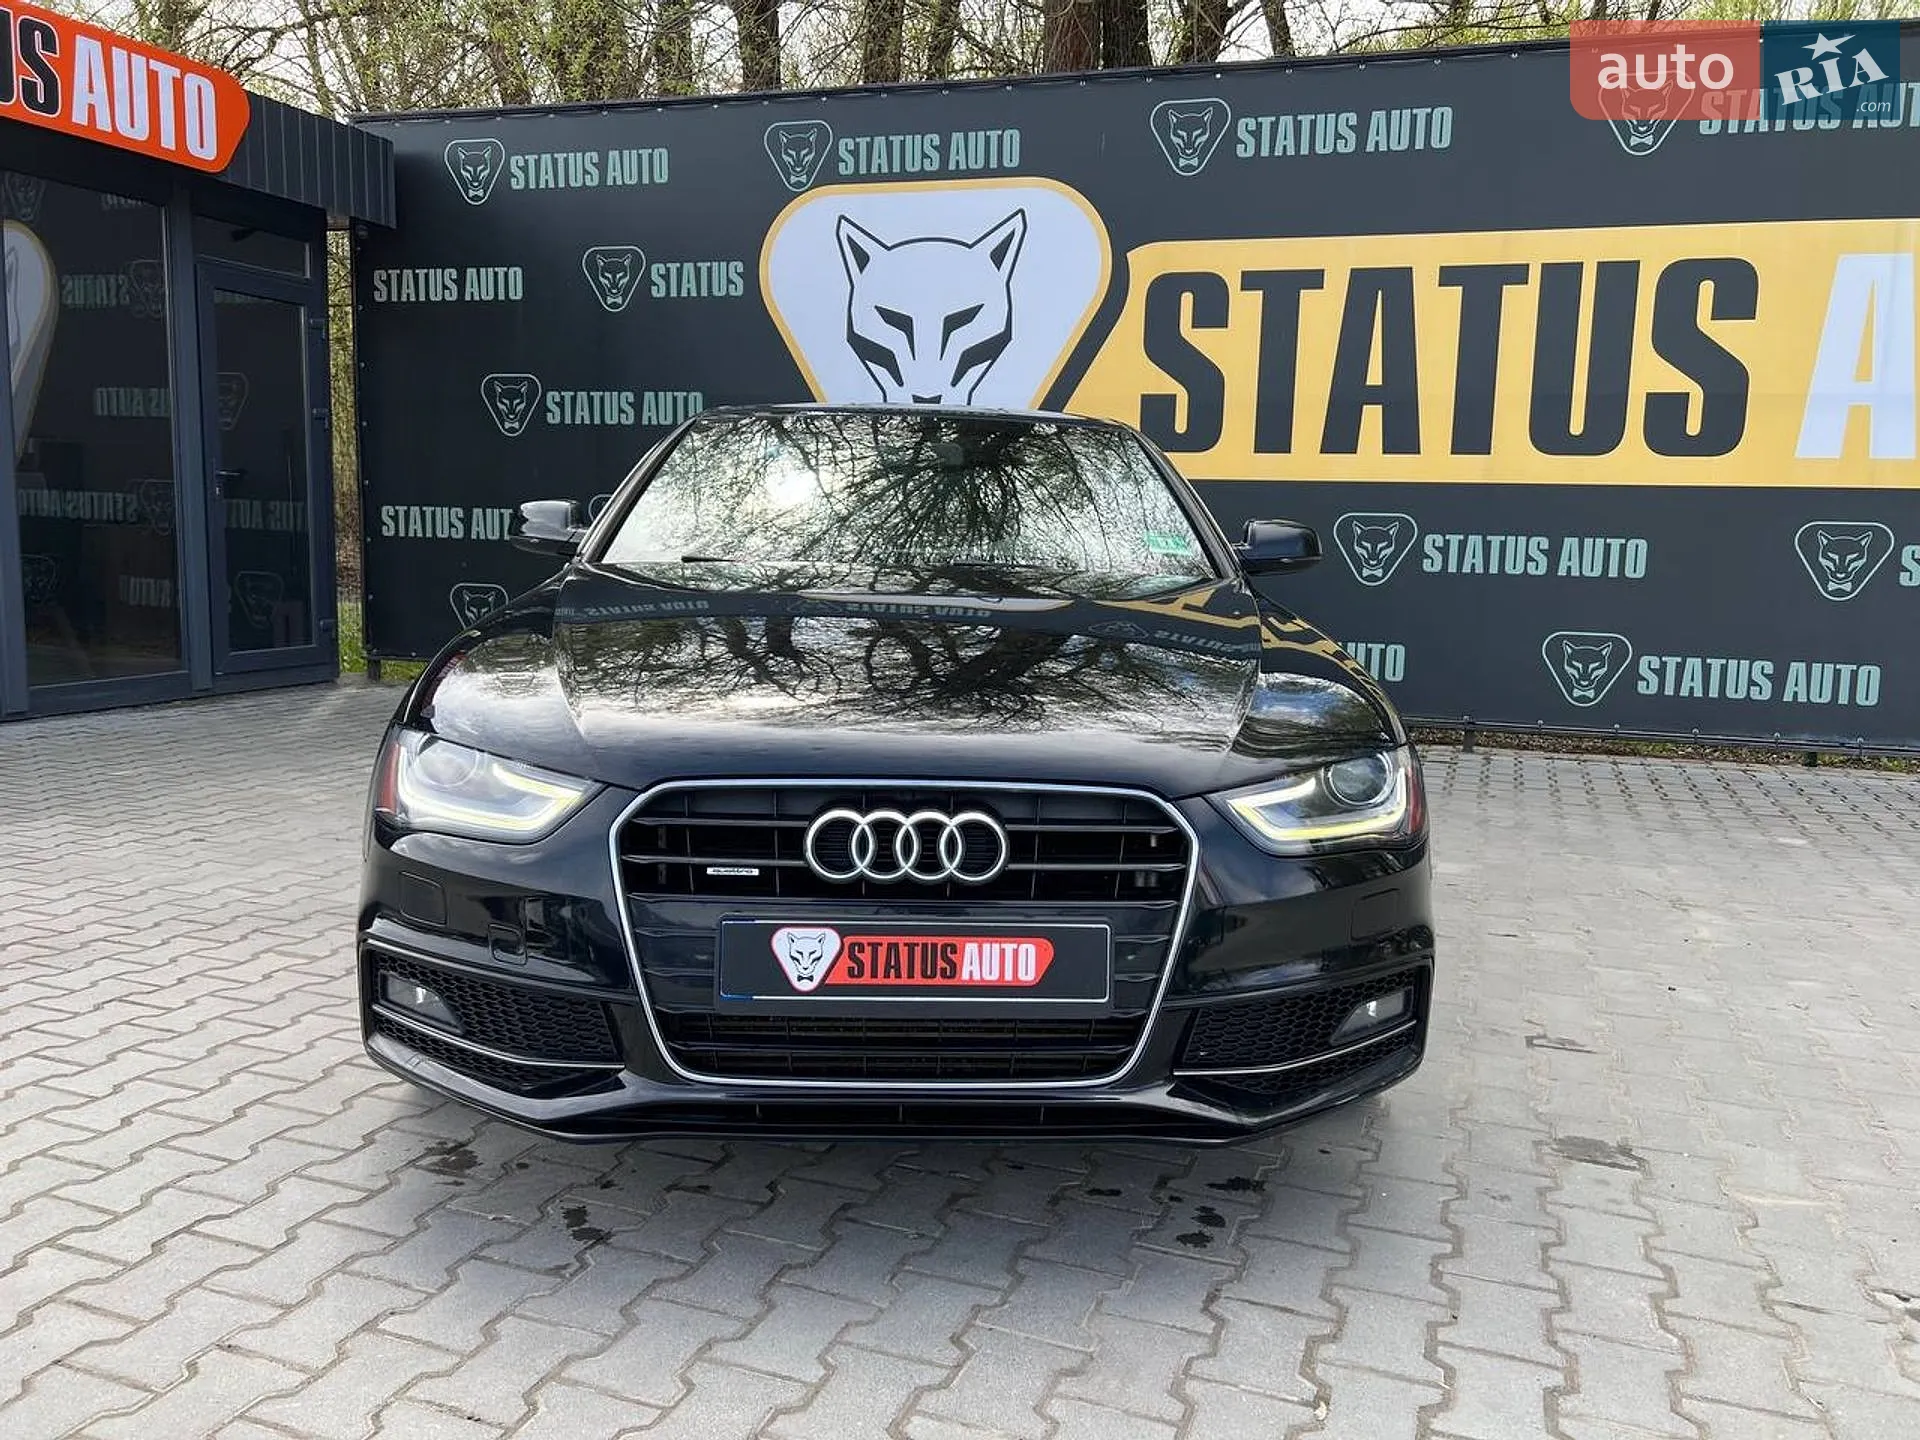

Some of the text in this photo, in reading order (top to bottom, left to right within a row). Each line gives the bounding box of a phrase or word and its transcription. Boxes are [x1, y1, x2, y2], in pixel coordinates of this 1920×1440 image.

[71, 34, 218, 161] AUTO
[1700, 85, 1842, 135] STATUS
[837, 129, 1021, 176] STATUS AUTO
[1236, 106, 1453, 159] STATUS AUTO
[509, 148, 670, 190] STATUS AUTO
[373, 266, 524, 303] STATUS AUTO
[650, 261, 744, 298] STATUS
[1140, 257, 1760, 458] STATUS
[545, 391, 704, 426] STATUS AUTO
[381, 505, 513, 540] STATUS AUT
[1421, 533, 1648, 579] STATUS AUTO
[1337, 641, 1405, 682] UTO
[1637, 655, 1881, 706] STATUS AUTO
[846, 941, 1037, 982] STATUS AUTO
